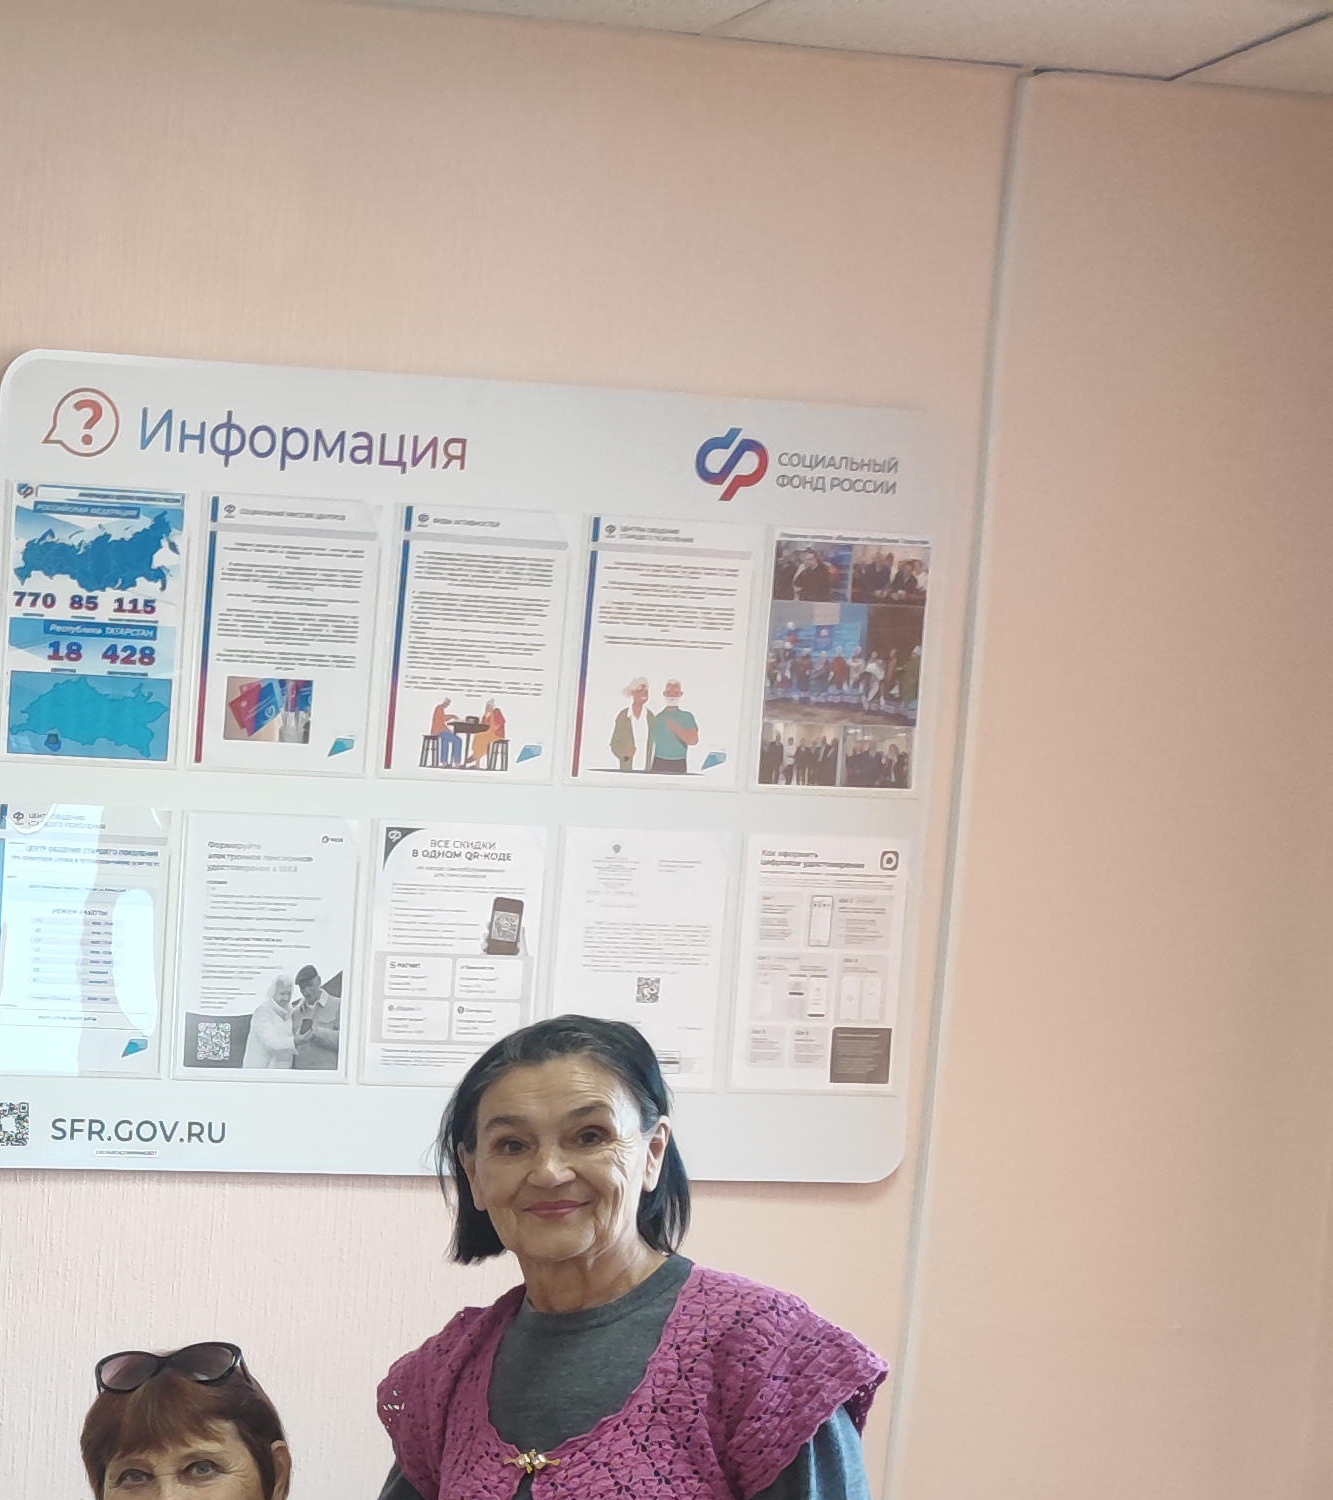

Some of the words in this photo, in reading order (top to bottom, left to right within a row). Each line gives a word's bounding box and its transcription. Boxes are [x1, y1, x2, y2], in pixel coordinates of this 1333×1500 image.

[140, 406, 468, 475] Информация
[777, 451, 899, 474] СОЦИАЛЬНЫЙ
[776, 475, 827, 494] ФОНД
[830, 477, 898, 496] РОССИИ
[13, 591, 57, 609] 770
[69, 595, 99, 612] 85
[113, 597, 157, 615] 115
[48, 640, 83, 662] 18
[102, 643, 157, 666] 428
[422, 850, 462, 859] ОДНОМ
[464, 852, 513, 862] QR-КОДЕ
[430, 840, 451, 848] ВСЕ
[452, 840, 497, 850] СКИДКИ
[50, 1117, 226, 1145] SFR.GOV.RU
